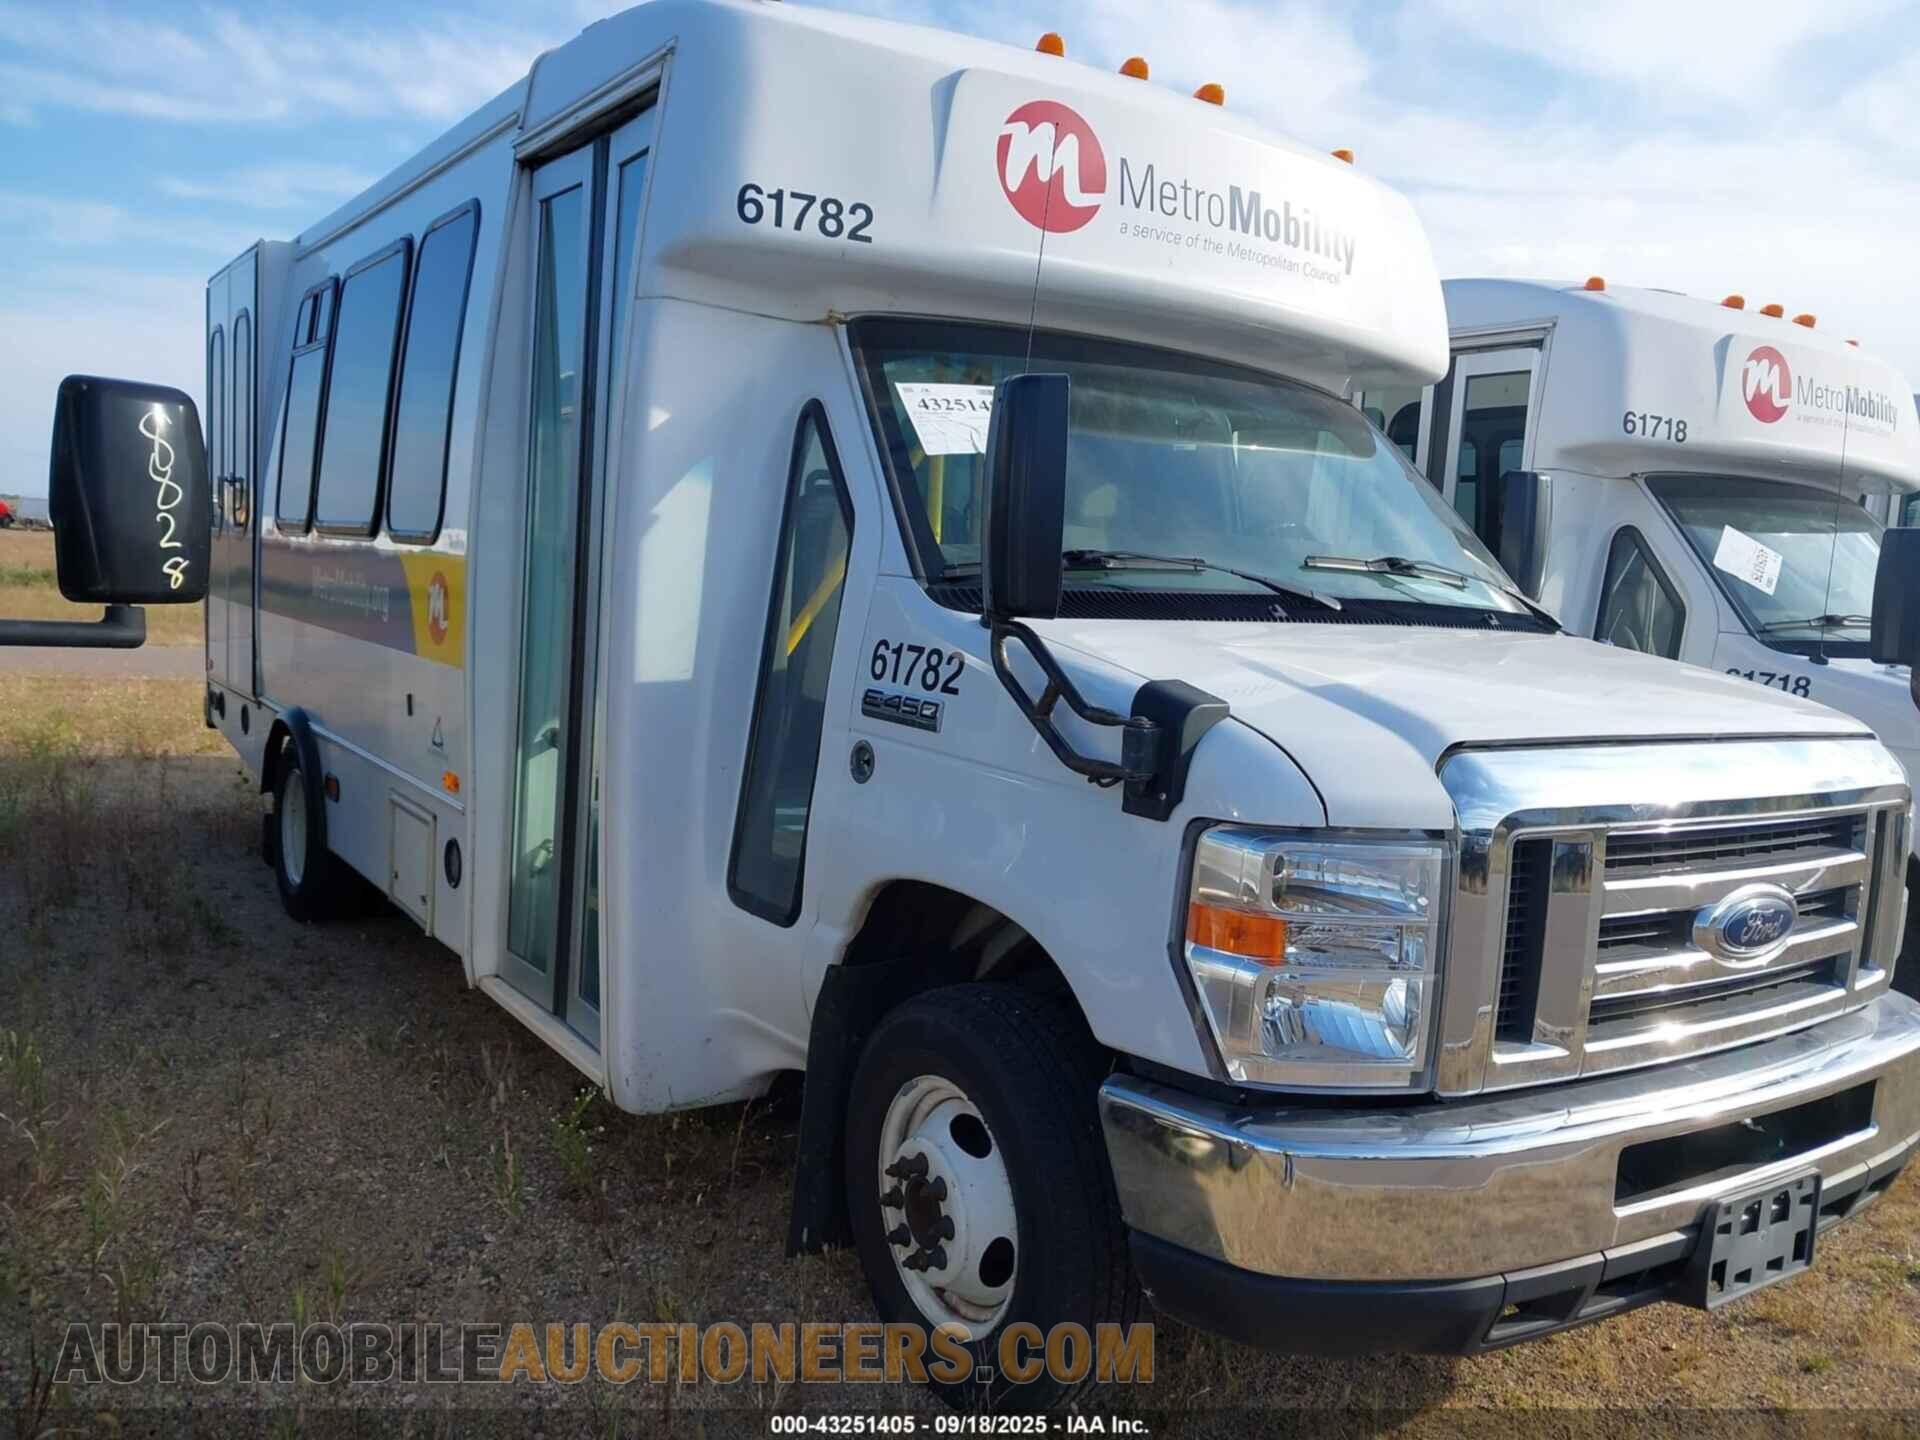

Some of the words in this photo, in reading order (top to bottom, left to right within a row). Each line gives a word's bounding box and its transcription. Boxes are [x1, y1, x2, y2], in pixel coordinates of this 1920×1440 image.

[737, 183, 874, 243] 61782
[1119, 157, 1356, 276] MetroMobility
[1119, 221, 1129, 235] a
[1132, 222, 1182, 245] service
[1185, 233, 1200, 249] of
[1203, 237, 1224, 255] the
[1226, 241, 1300, 274] Metropolitan
[1302, 261, 1341, 286] Council
[917, 397, 992, 412] 432514
[1623, 410, 1688, 443] 61718
[1796, 375, 1898, 432] MetroMobility
[870, 639, 965, 696] 61782
[1726, 668, 1811, 698] 718
[1740, 908, 1785, 944] Ford
